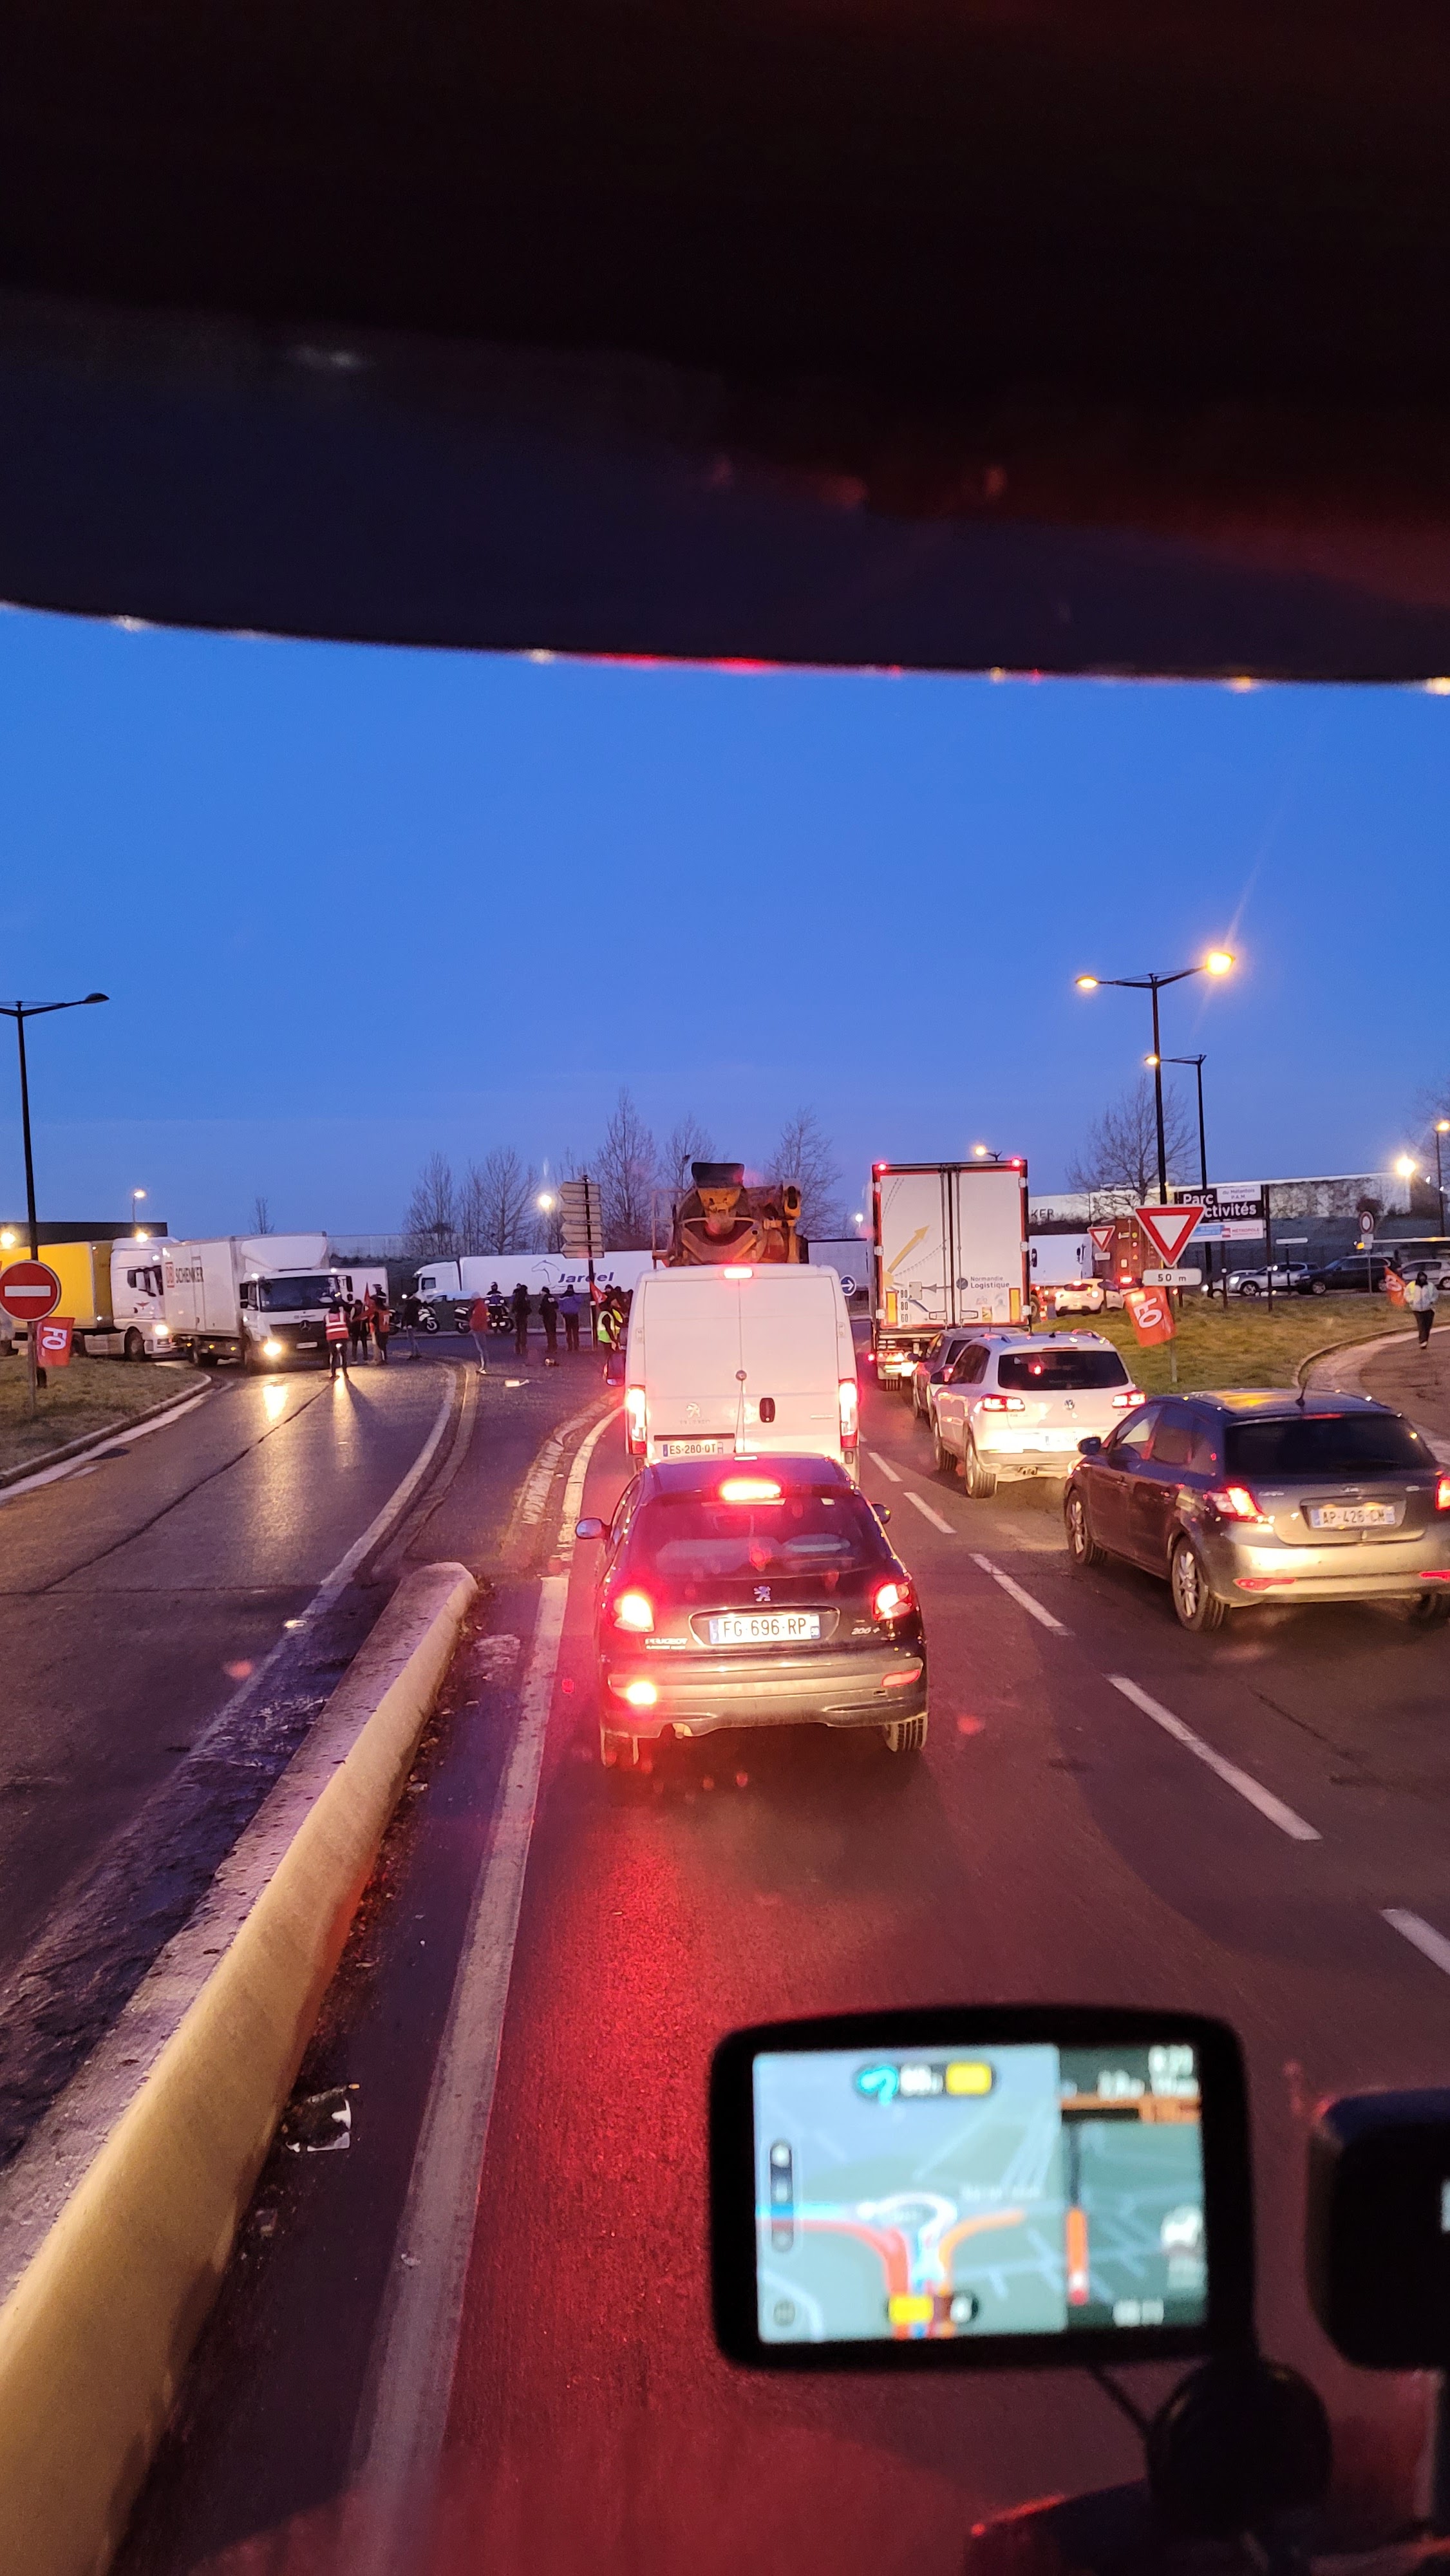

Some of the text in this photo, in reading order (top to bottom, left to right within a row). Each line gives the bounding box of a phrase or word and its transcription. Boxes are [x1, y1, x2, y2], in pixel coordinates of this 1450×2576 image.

[1183, 1193, 1214, 1204] Parc
[1205, 1201, 1257, 1218] ctivités
[1158, 1273, 1172, 1282] 50
[901, 1302, 908, 1310] 80
[901, 1314, 908, 1322] 60
[1133, 1298, 1162, 1328] FO
[42, 1327, 67, 1350] FO
